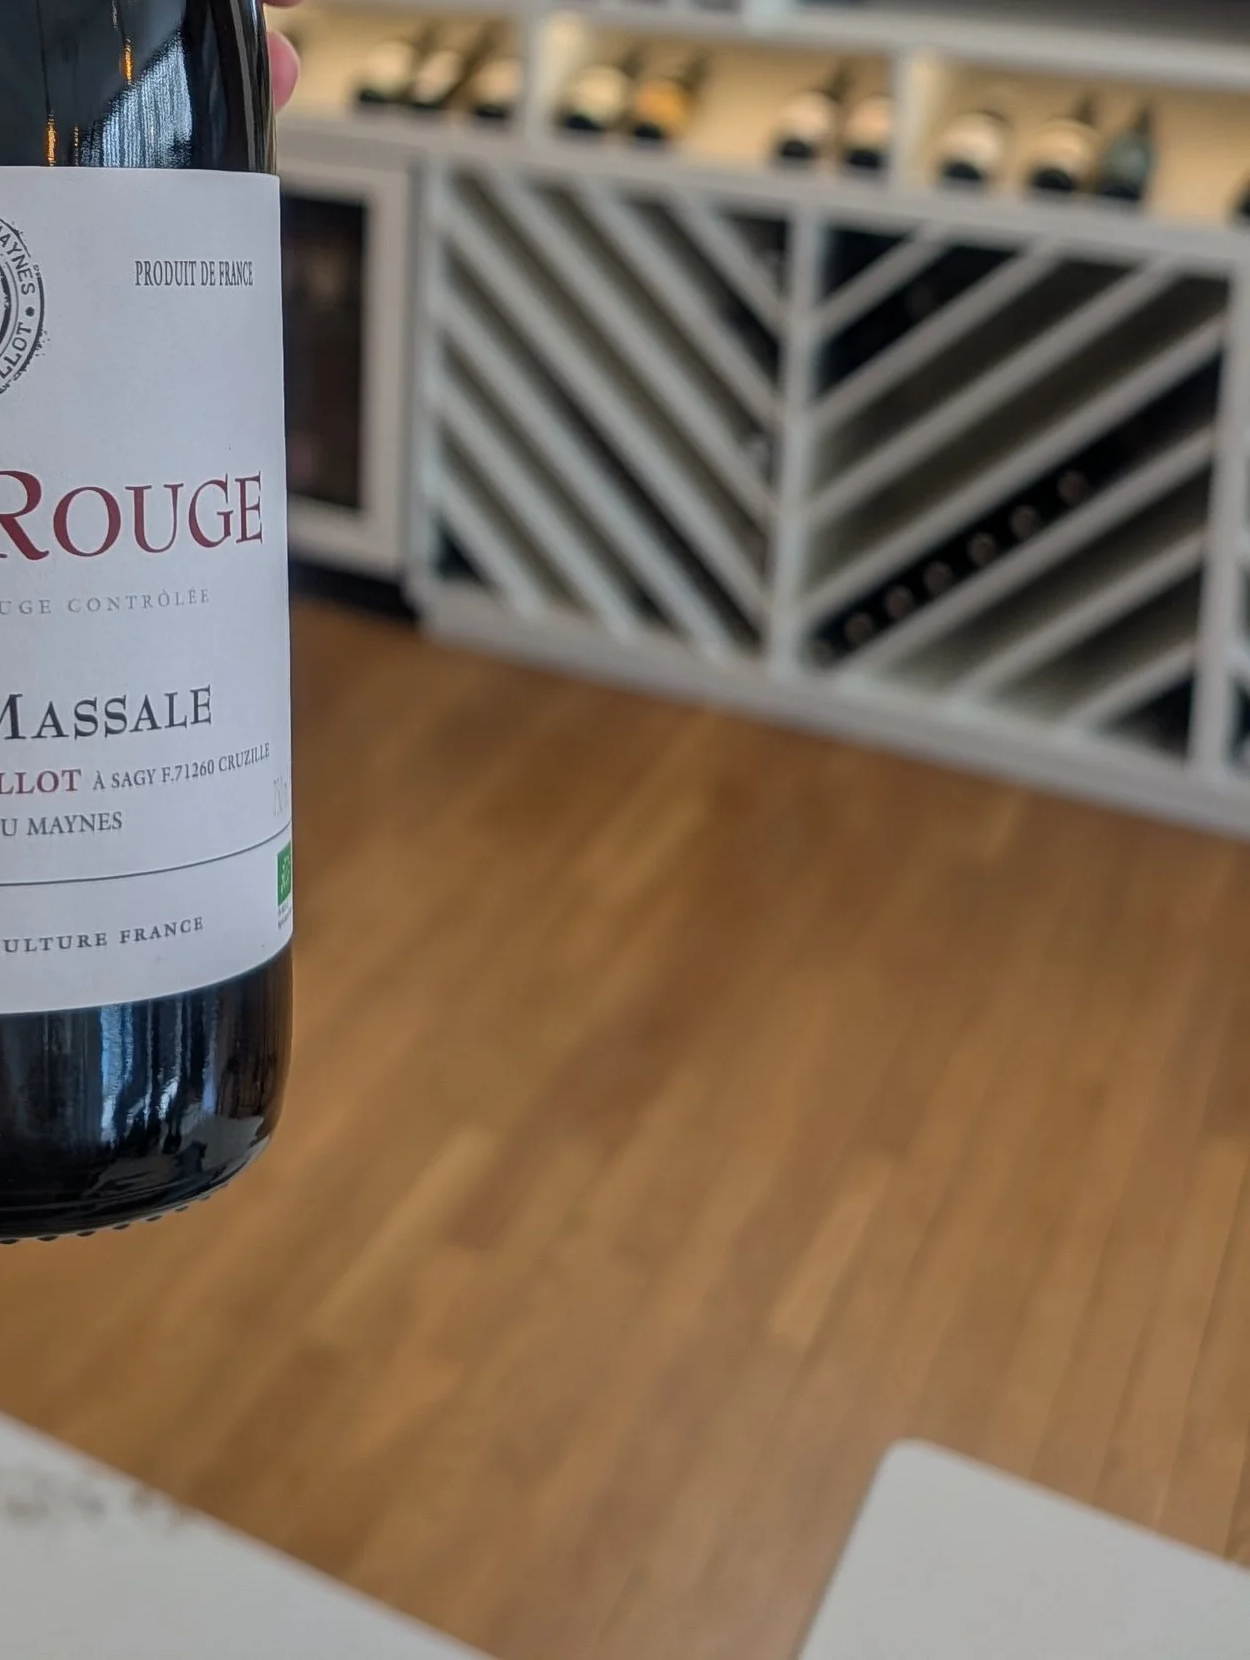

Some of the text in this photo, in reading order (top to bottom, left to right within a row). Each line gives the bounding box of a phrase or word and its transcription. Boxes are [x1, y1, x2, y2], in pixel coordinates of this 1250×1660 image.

[134, 260, 254, 286] PRODUIT DE FRANCE
[111, 768, 157, 789] SAGY
[161, 758, 214, 784] F.71260
[218, 742, 270, 773] CRUZILLE
[26, 811, 123, 837] MAYNES
[118, 916, 203, 945] FRANCE
